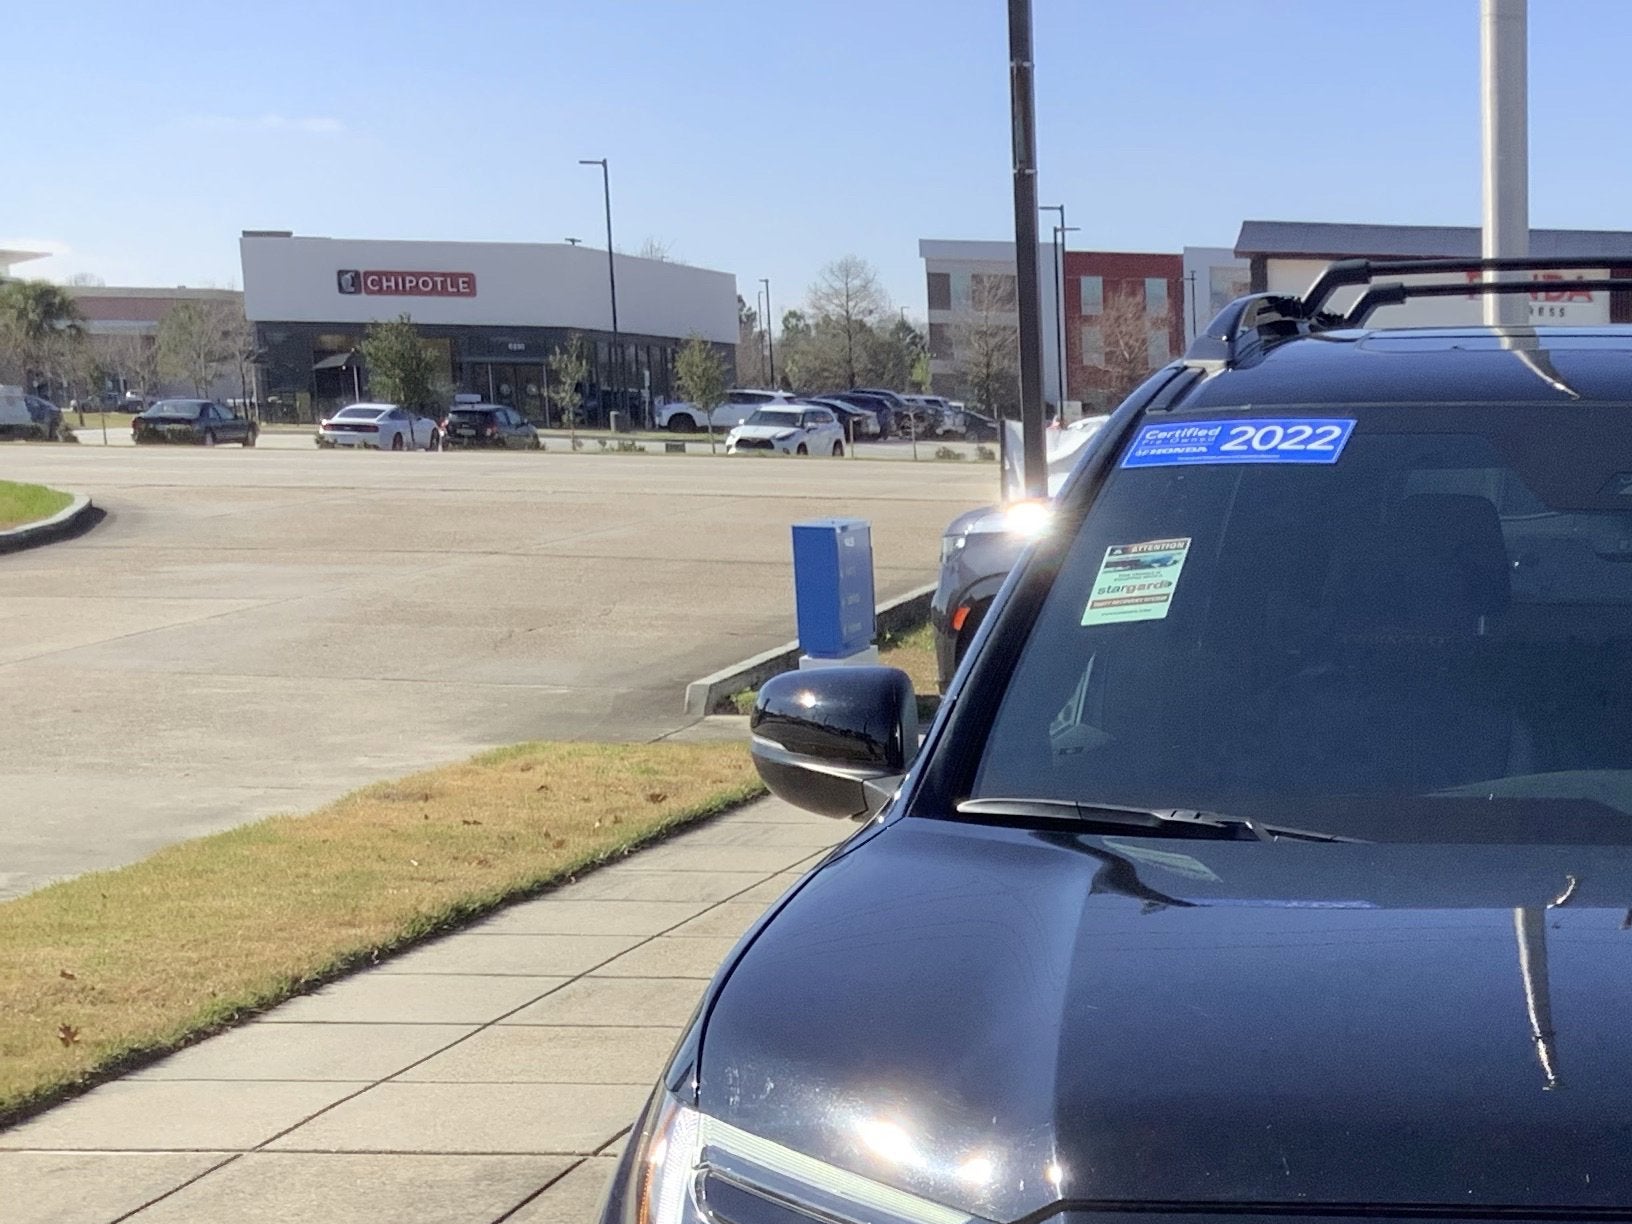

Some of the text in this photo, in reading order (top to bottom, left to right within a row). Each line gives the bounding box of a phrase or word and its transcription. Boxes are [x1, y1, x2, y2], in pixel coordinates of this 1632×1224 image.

[366, 275, 471, 293] CHIPOTLE
[1145, 426, 1222, 440] Certified
[1219, 425, 1343, 452] 2022
[1149, 446, 1208, 456] HONDA
[1131, 541, 1185, 553] ATTENTION
